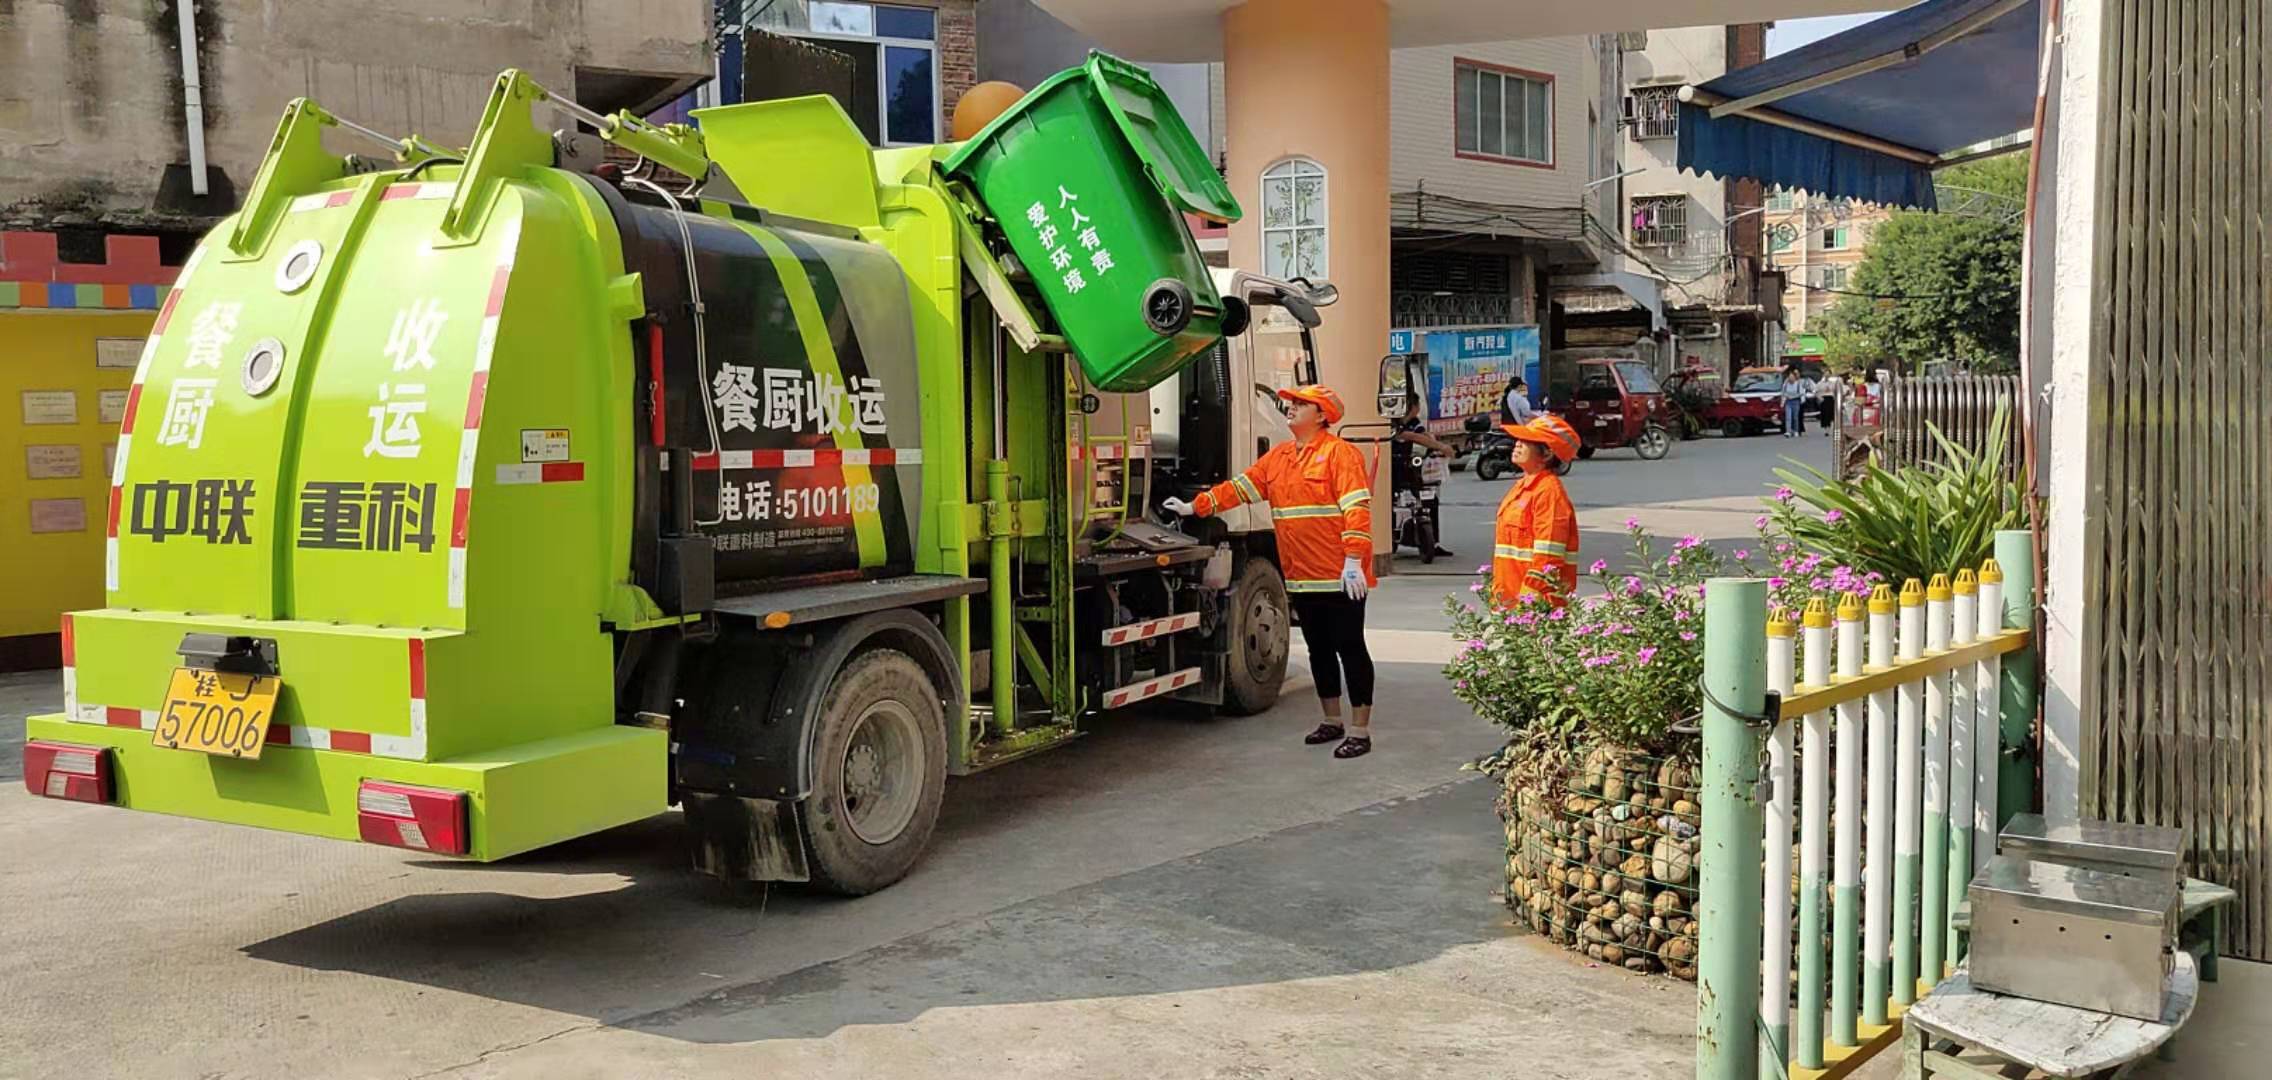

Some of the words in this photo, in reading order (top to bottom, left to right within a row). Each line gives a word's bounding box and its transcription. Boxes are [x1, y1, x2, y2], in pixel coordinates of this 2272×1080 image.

[1026, 200, 1086, 294] 爱护环境
[1058, 184, 1115, 276] 人人有责
[156, 300, 242, 450] 餐厨
[362, 297, 449, 459] 收运
[712, 361, 888, 435] 餐厨收运
[130, 479, 256, 545] 中联
[296, 480, 438, 554] 重科
[161, 699, 263, 752] 57006
